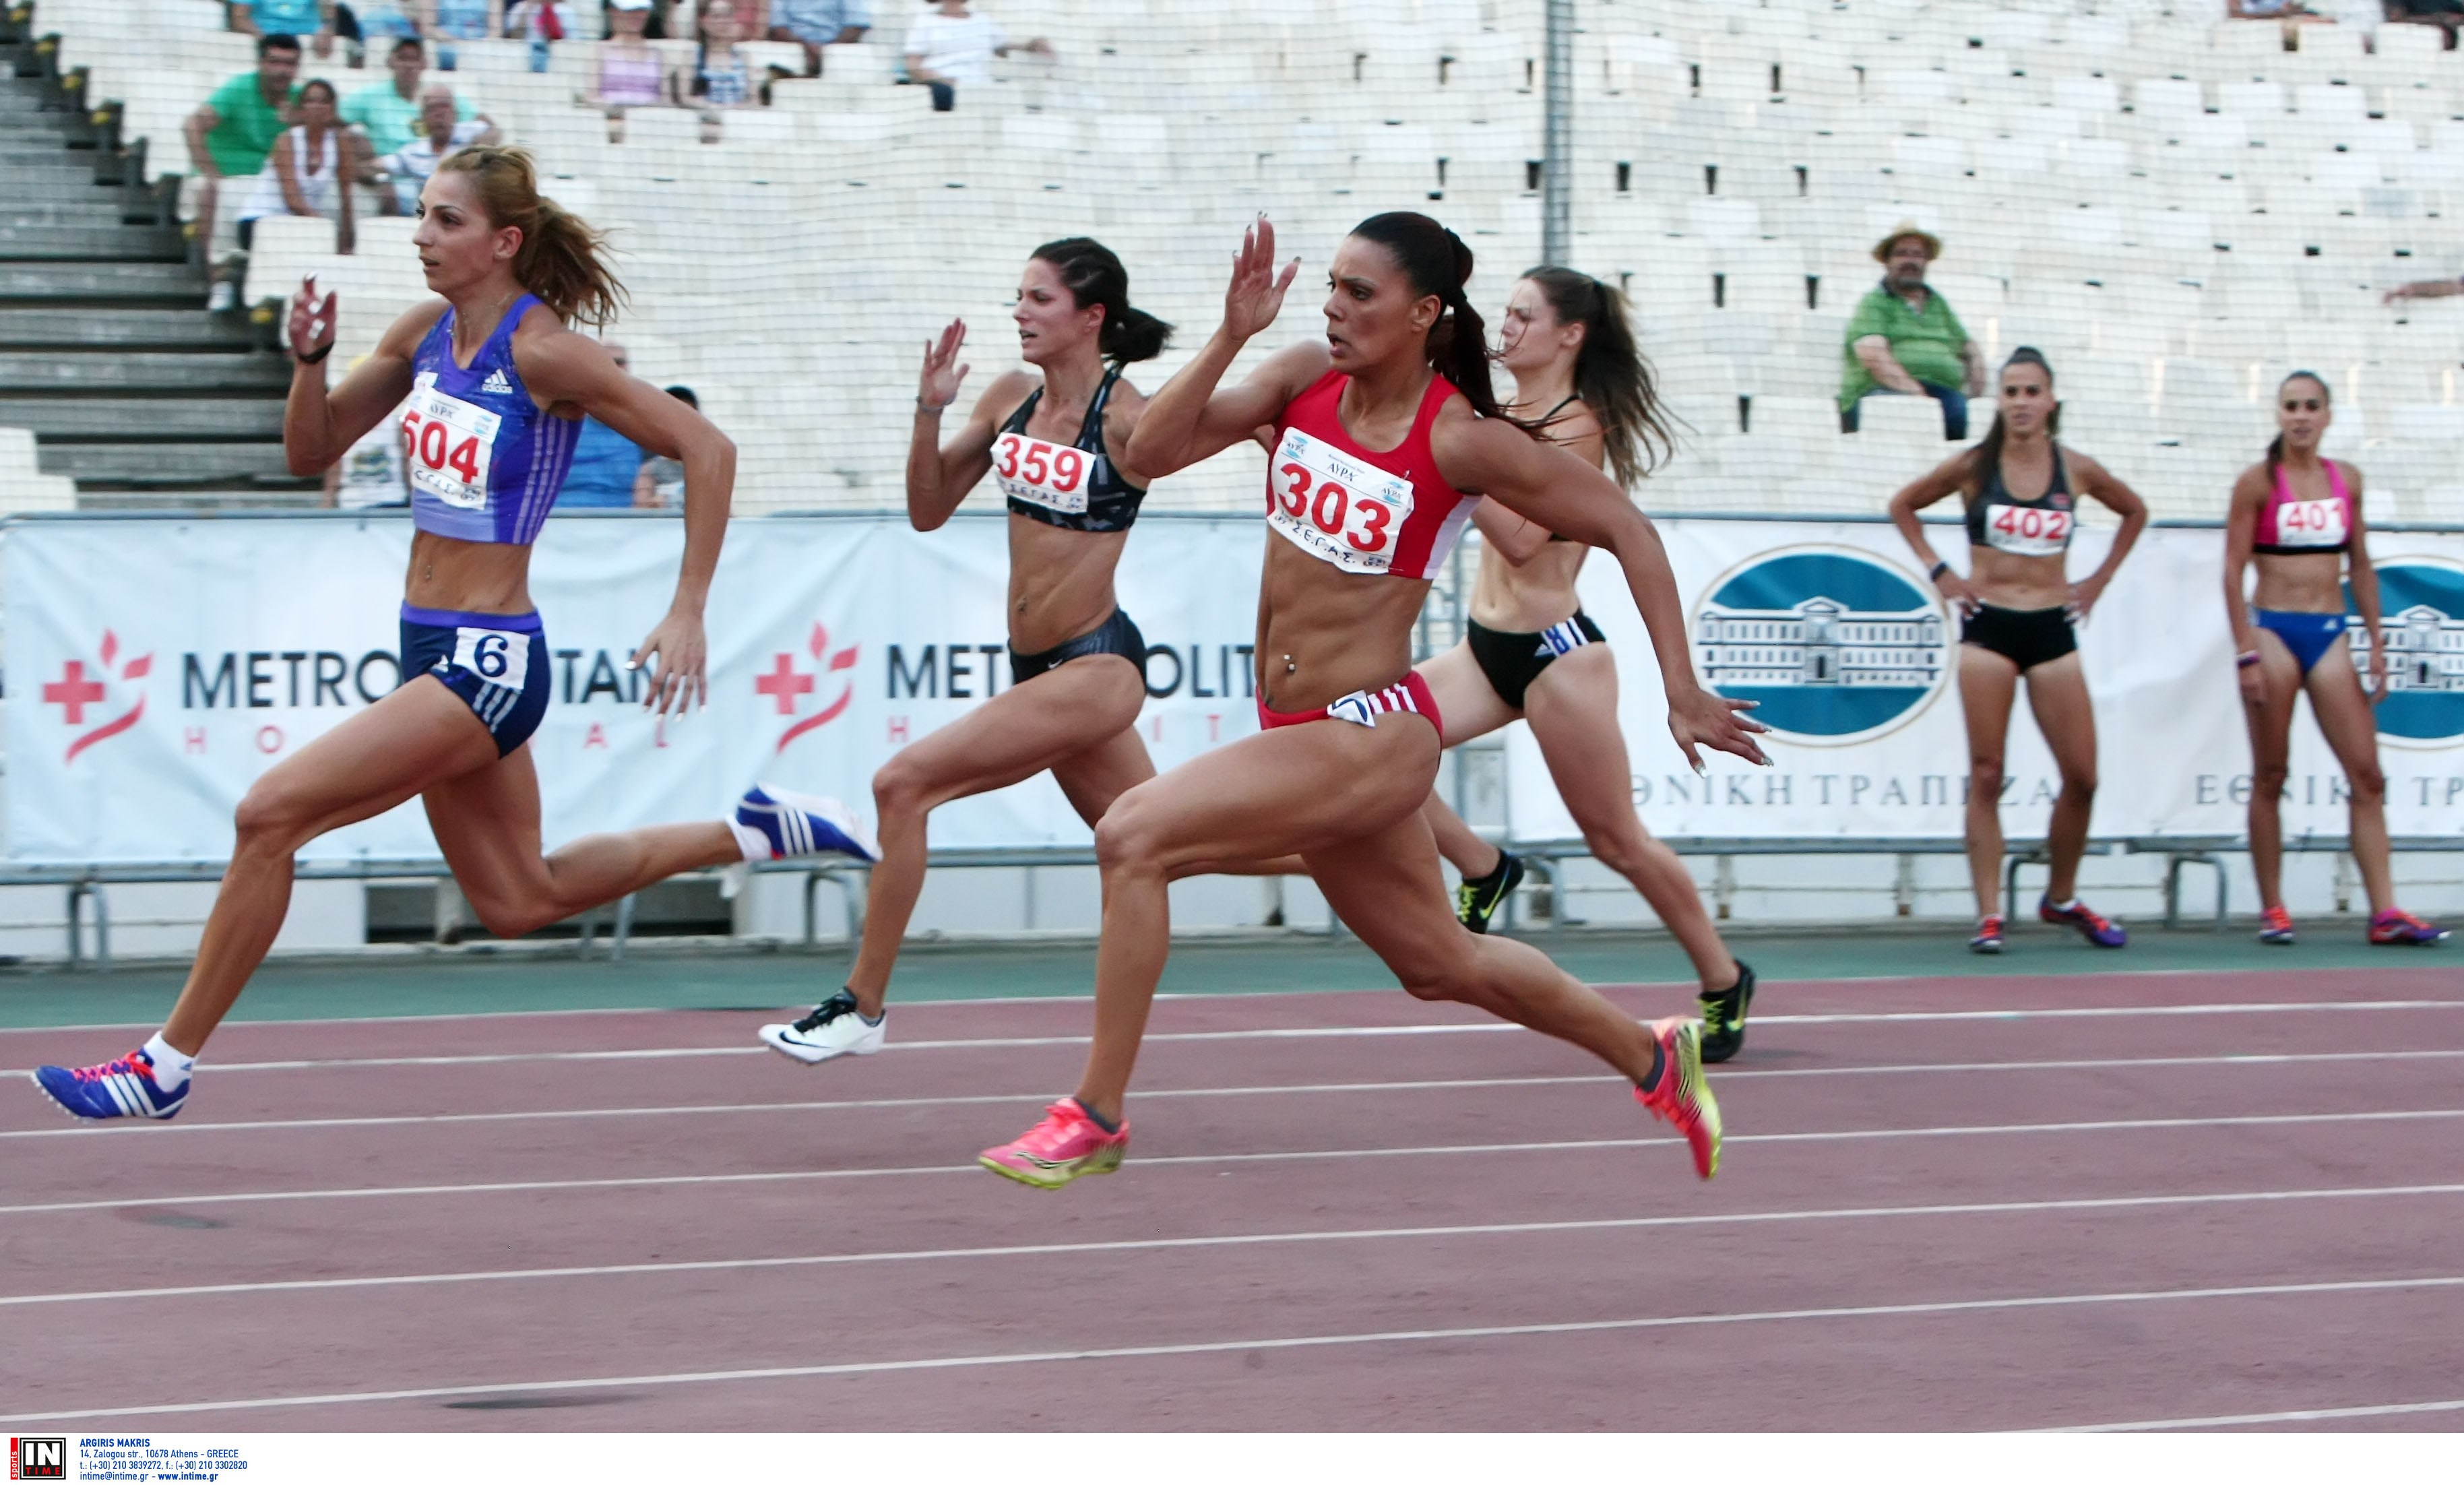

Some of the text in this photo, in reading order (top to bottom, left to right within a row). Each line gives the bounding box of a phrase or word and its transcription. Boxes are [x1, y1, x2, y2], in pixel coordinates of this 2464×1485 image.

[402, 408, 480, 484] 504
[997, 437, 1083, 492] 359
[1278, 462, 1391, 552] 303
[1994, 505, 2066, 541] 402
[2285, 502, 2347, 532] 401
[474, 634, 509, 677] 6
